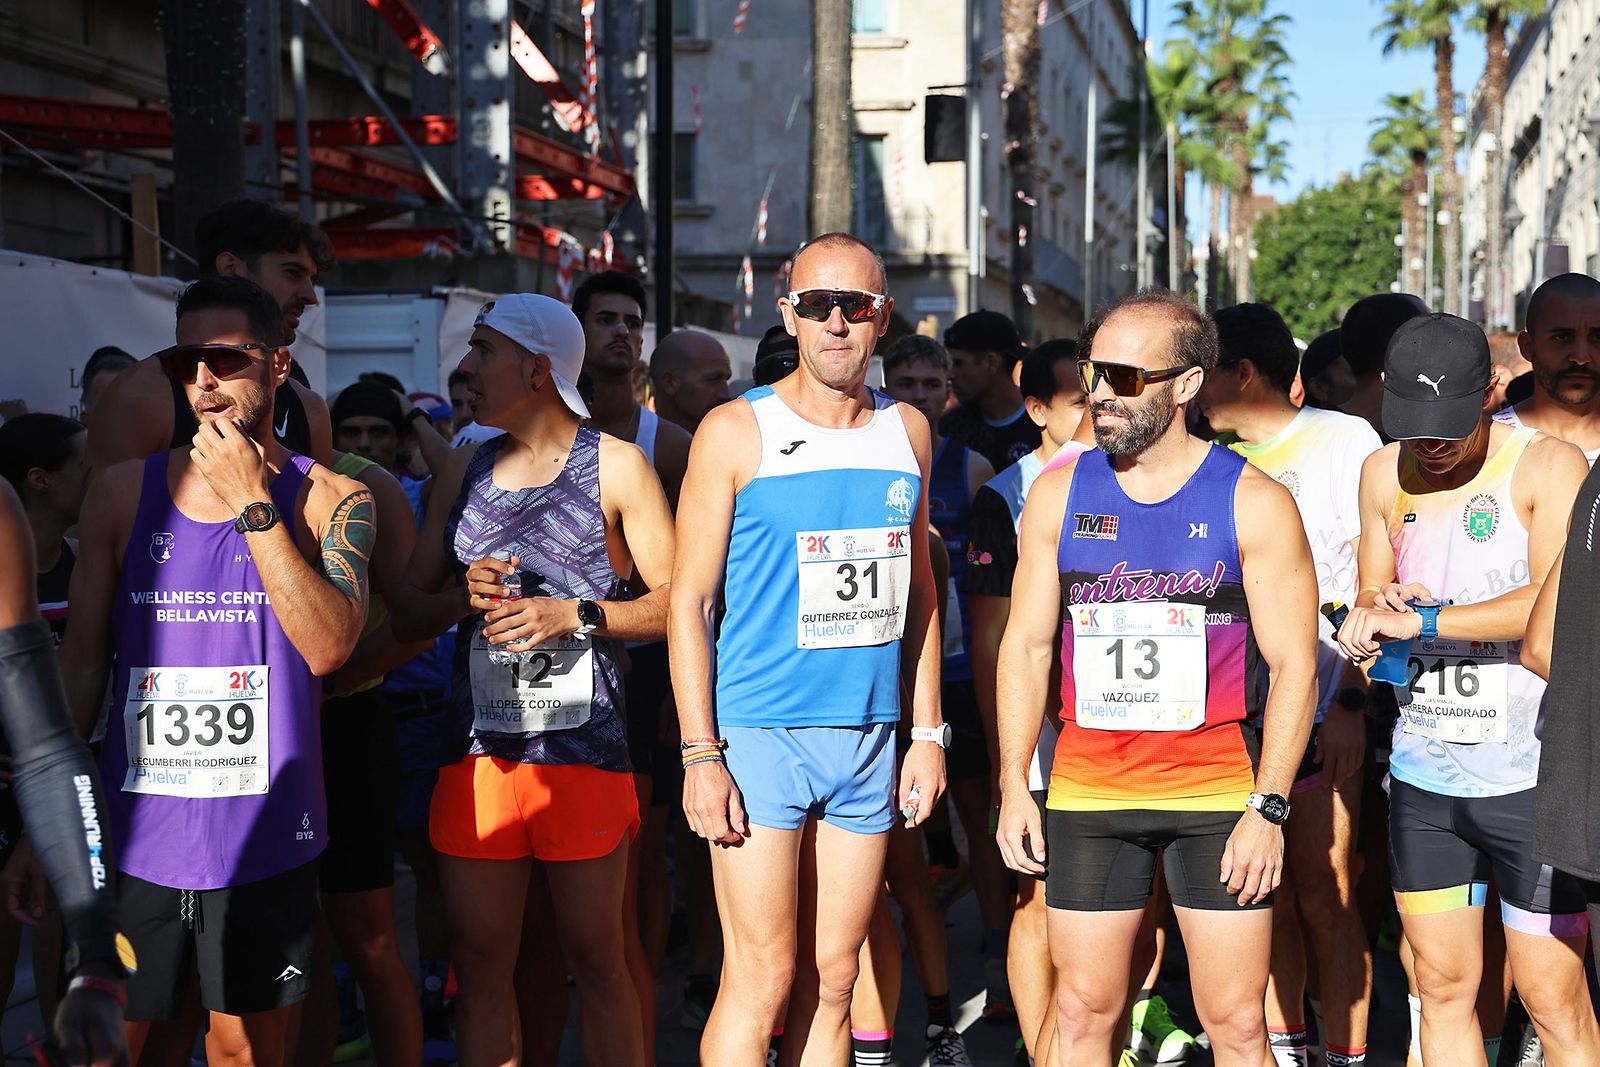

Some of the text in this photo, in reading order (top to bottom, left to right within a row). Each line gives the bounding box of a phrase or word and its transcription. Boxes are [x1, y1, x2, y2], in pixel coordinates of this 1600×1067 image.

[807, 535, 831, 554] 21K
[836, 561, 878, 602] 31
[1071, 561, 1225, 605] entrena!
[131, 591, 217, 605] WELLNESS
[156, 609, 258, 623] BELLAVISTA
[801, 606, 900, 623] GUTIERREZ GONZALEZ
[1204, 612, 1232, 626] NING
[804, 622, 855, 638] Huelva
[1106, 638, 1161, 680] 13
[512, 652, 552, 689] 12
[1407, 656, 1480, 698] 216
[229, 670, 257, 691] 21K
[228, 689, 257, 699] HUELVA
[1102, 692, 1160, 704] VAZQUEZ
[490, 699, 562, 709] LOPEZ COTO
[1081, 702, 1128, 718] Huelva
[1435, 706, 1497, 718] CUADRADO
[479, 707, 522, 721] Huelva
[1403, 710, 1437, 729] Huelva
[136, 702, 255, 747] 1339
[131, 756, 257, 767] LECUMBERRI RODRIGUEZ
[133, 768, 188, 785] Huelva
[296, 830, 314, 840] BY2
